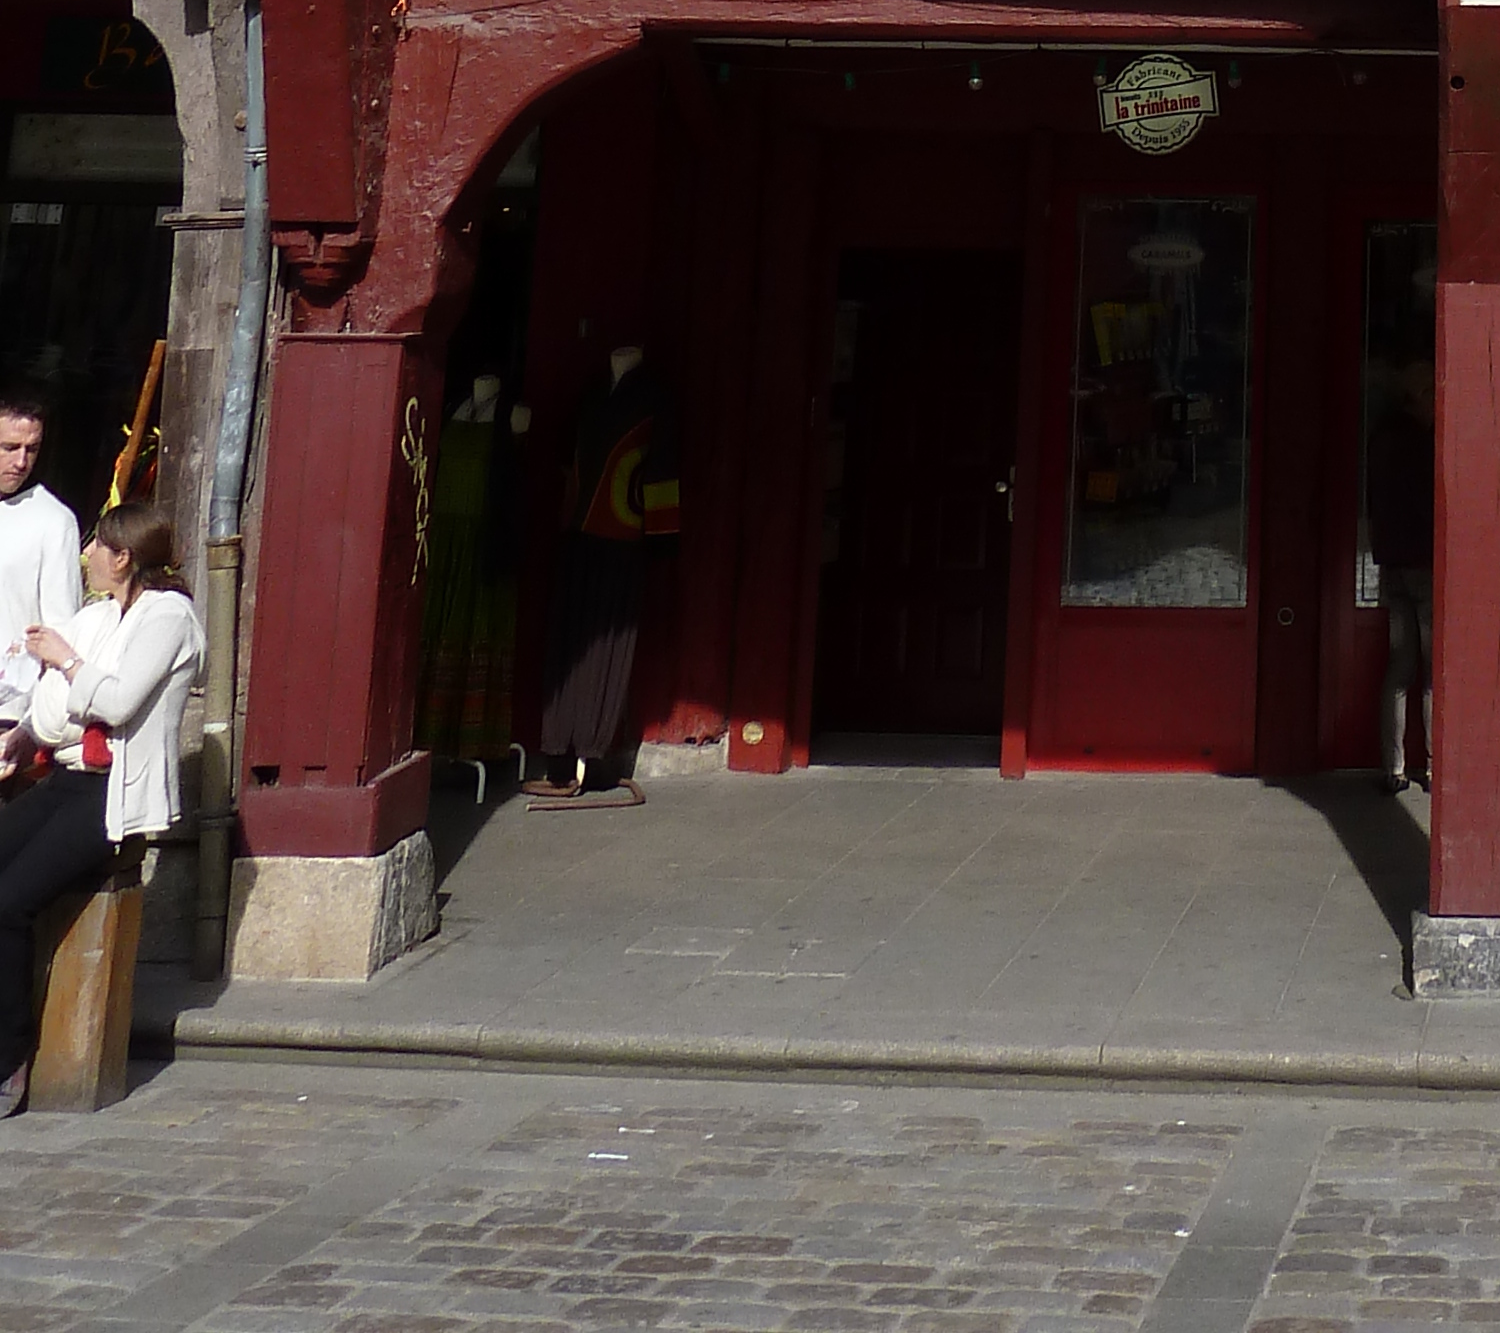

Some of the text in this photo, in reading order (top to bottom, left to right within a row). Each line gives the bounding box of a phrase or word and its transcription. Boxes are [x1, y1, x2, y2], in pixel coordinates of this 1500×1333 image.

[1127, 66, 1182, 87] Fabricant
[1115, 94, 1201, 119] la trinitaine
[1131, 117, 1190, 145] Depuis 1955
